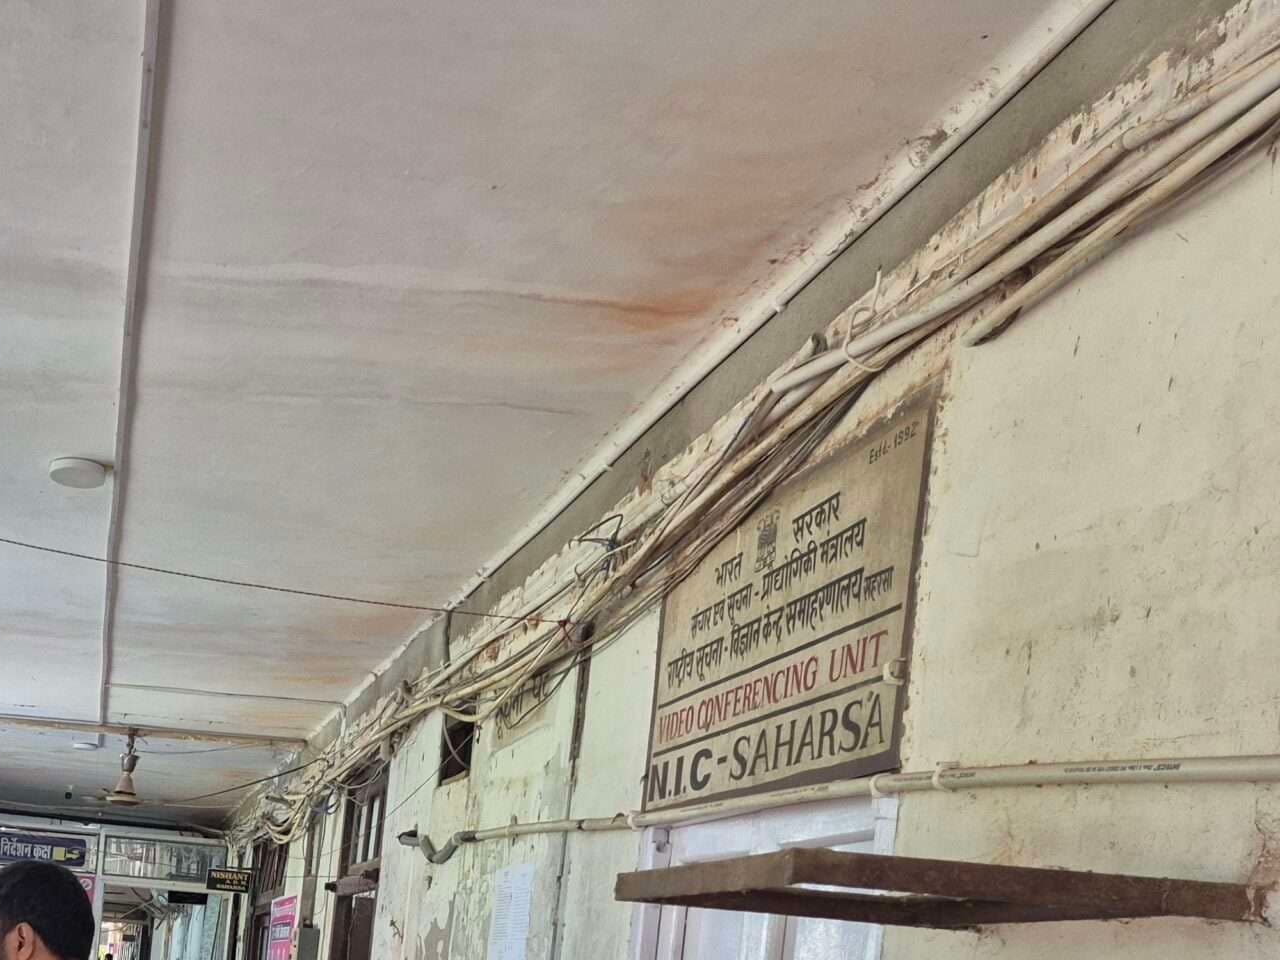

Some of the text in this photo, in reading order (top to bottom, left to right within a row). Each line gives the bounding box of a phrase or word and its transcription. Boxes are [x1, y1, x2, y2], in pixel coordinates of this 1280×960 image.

[691, 607, 713, 638] संचार
[819, 517, 867, 568] मंत्रालय
[715, 491, 841, 588] भारत सरकार
[786, 566, 865, 636] समाहरणालय
[864, 565, 894, 601] सहरसा
[658, 630, 889, 744] VIDEO CONFERENCING UNIT
